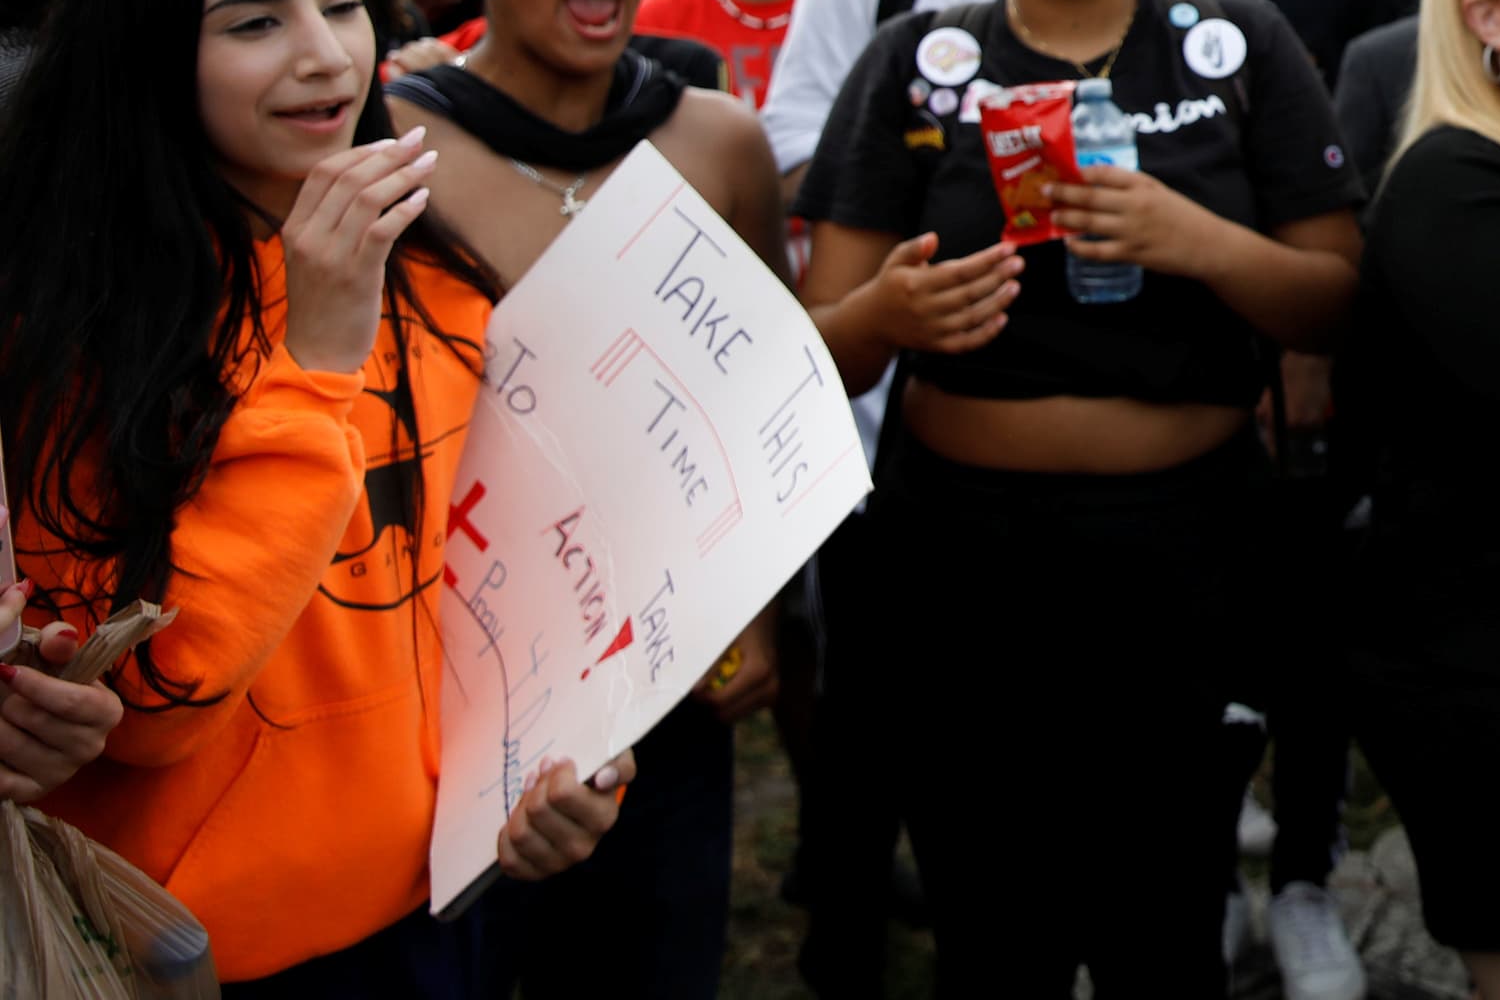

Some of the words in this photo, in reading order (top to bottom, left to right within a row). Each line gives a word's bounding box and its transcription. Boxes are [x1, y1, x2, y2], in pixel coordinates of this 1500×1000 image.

[497, 336, 537, 415] TO
[654, 205, 754, 375] TAKE
[759, 344, 824, 504] THIS
[647, 379, 709, 507] TIME
[640, 569, 675, 683] TAKE
